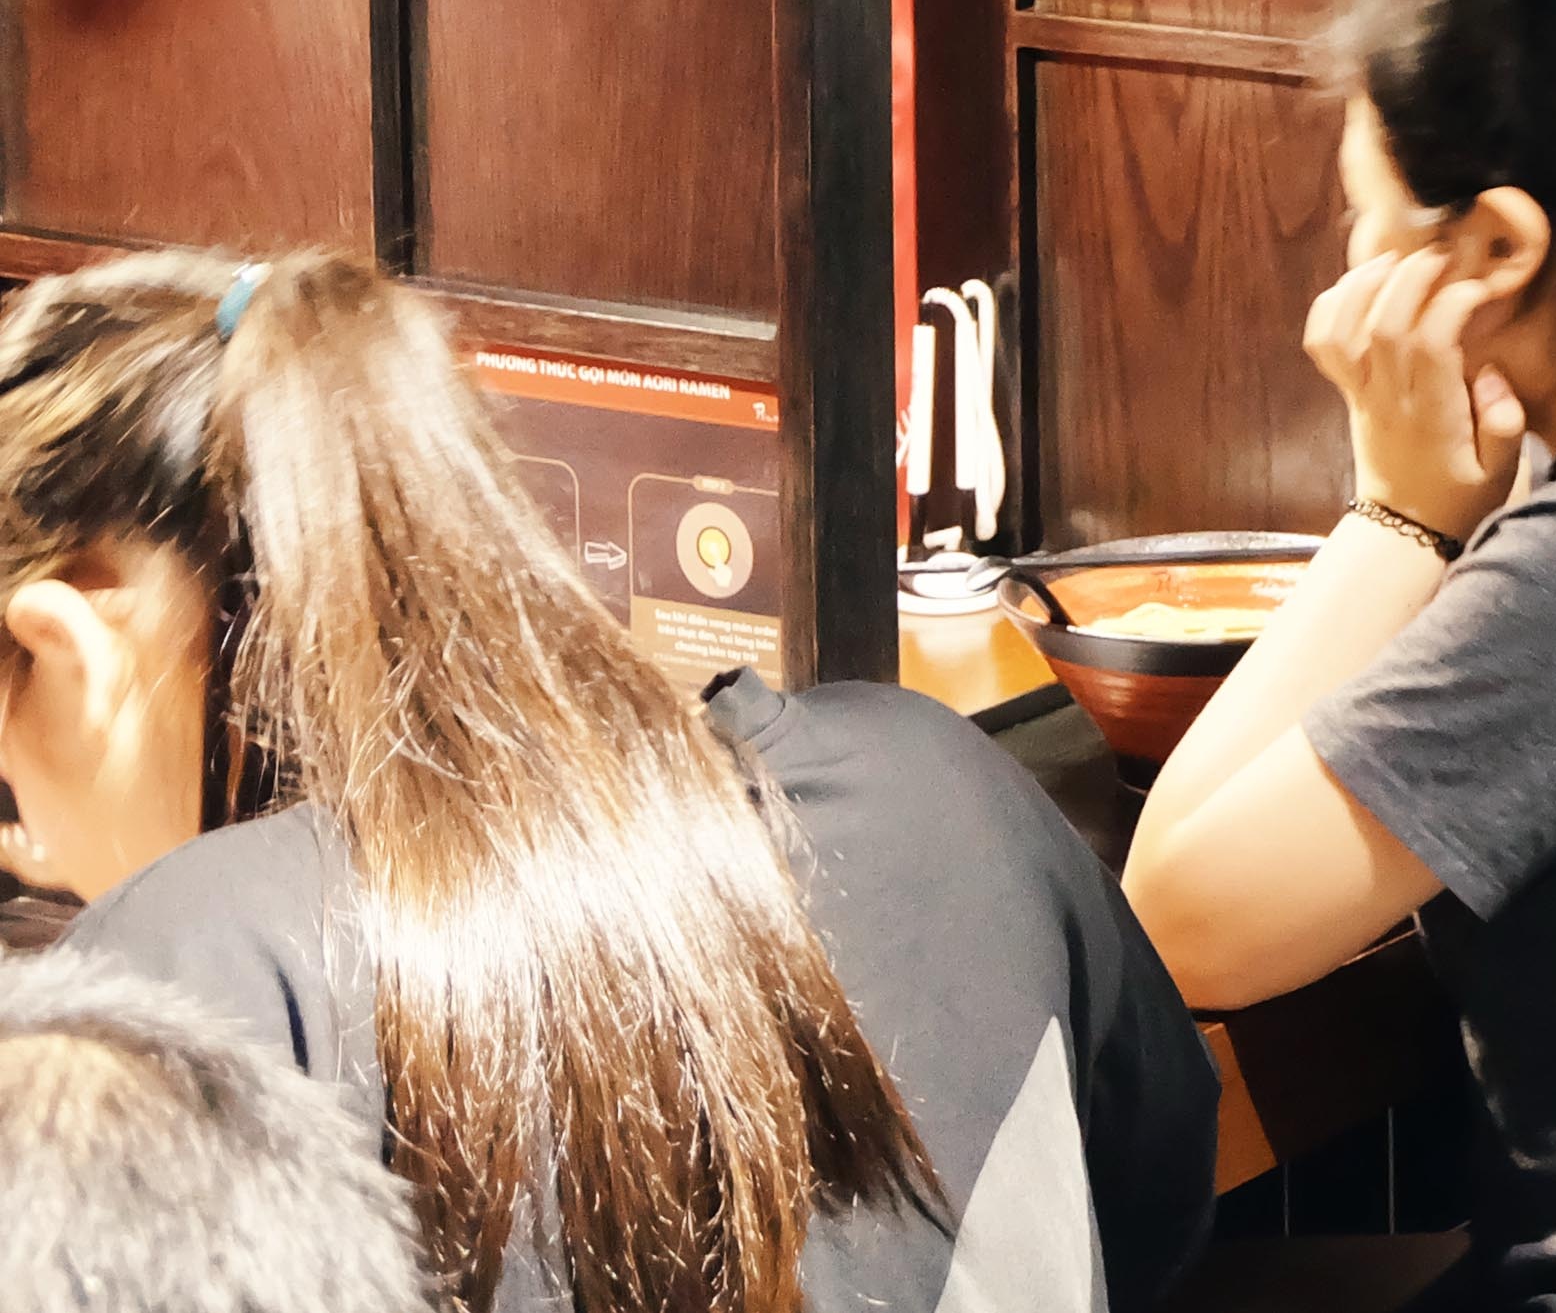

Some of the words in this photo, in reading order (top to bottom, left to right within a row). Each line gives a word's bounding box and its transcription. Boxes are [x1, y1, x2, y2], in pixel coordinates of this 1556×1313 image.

[476, 351, 537, 374] PHƯƠNG
[538, 359, 577, 380] THỨC
[578, 365, 605, 385] GỌI
[606, 368, 641, 388] MÓN
[643, 374, 678, 392] AORI
[679, 378, 731, 400] RAMEN
